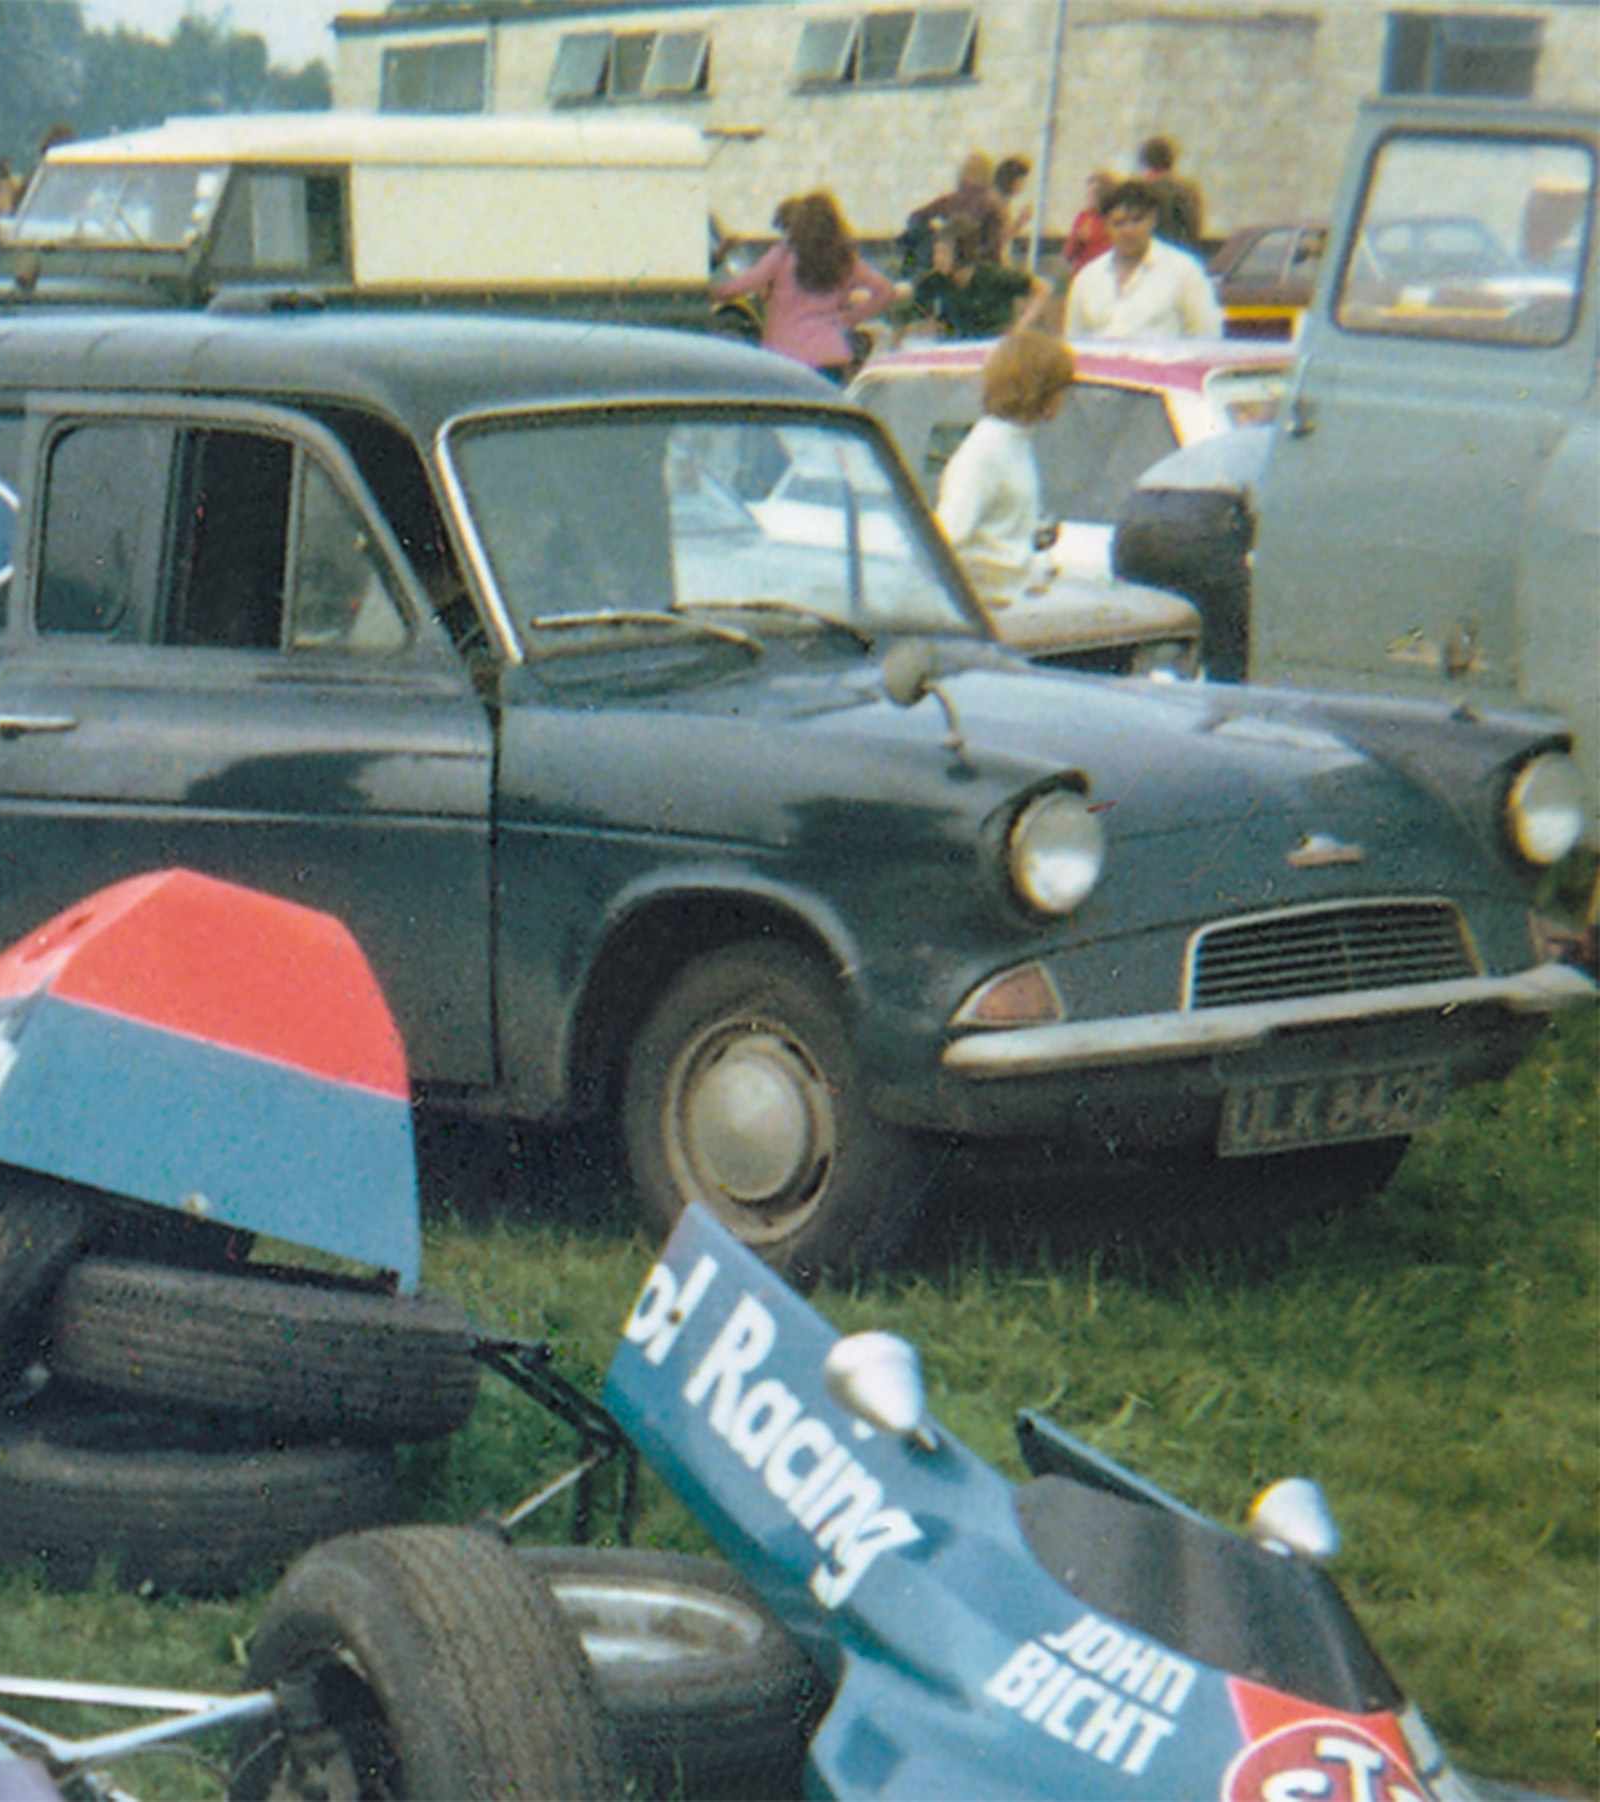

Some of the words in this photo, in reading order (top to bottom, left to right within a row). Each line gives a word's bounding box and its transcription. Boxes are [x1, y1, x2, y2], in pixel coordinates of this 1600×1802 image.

[683, 1293, 924, 1611] Racing
[983, 1641, 1176, 1775] BICHT
[1043, 1614, 1197, 1715] JOHN
